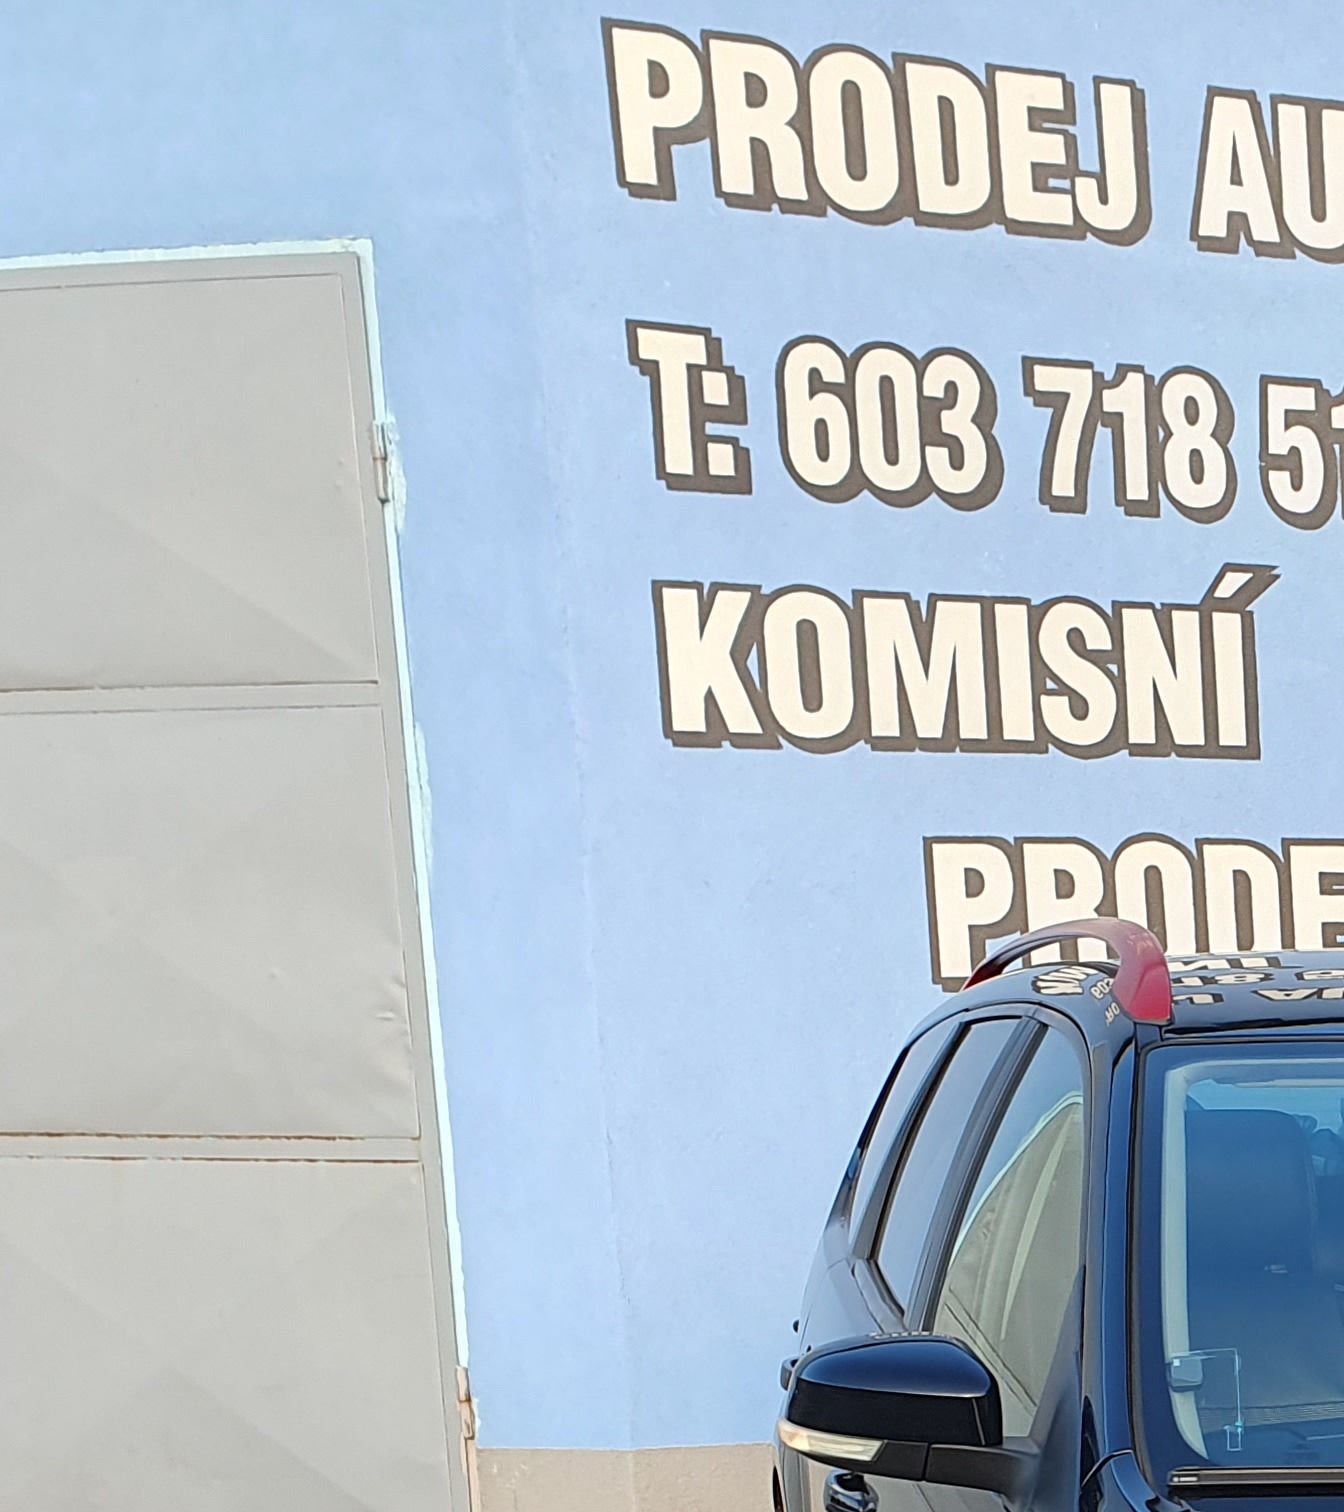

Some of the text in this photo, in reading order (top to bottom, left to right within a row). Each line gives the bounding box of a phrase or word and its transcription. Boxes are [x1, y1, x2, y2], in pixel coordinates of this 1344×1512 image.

[601, 17, 1152, 247] PRODEJ
[627, 320, 752, 494] T:
[776, 335, 1004, 511] 603
[1022, 356, 1238, 524] 718
[652, 563, 1279, 759] KOMISNÍ
